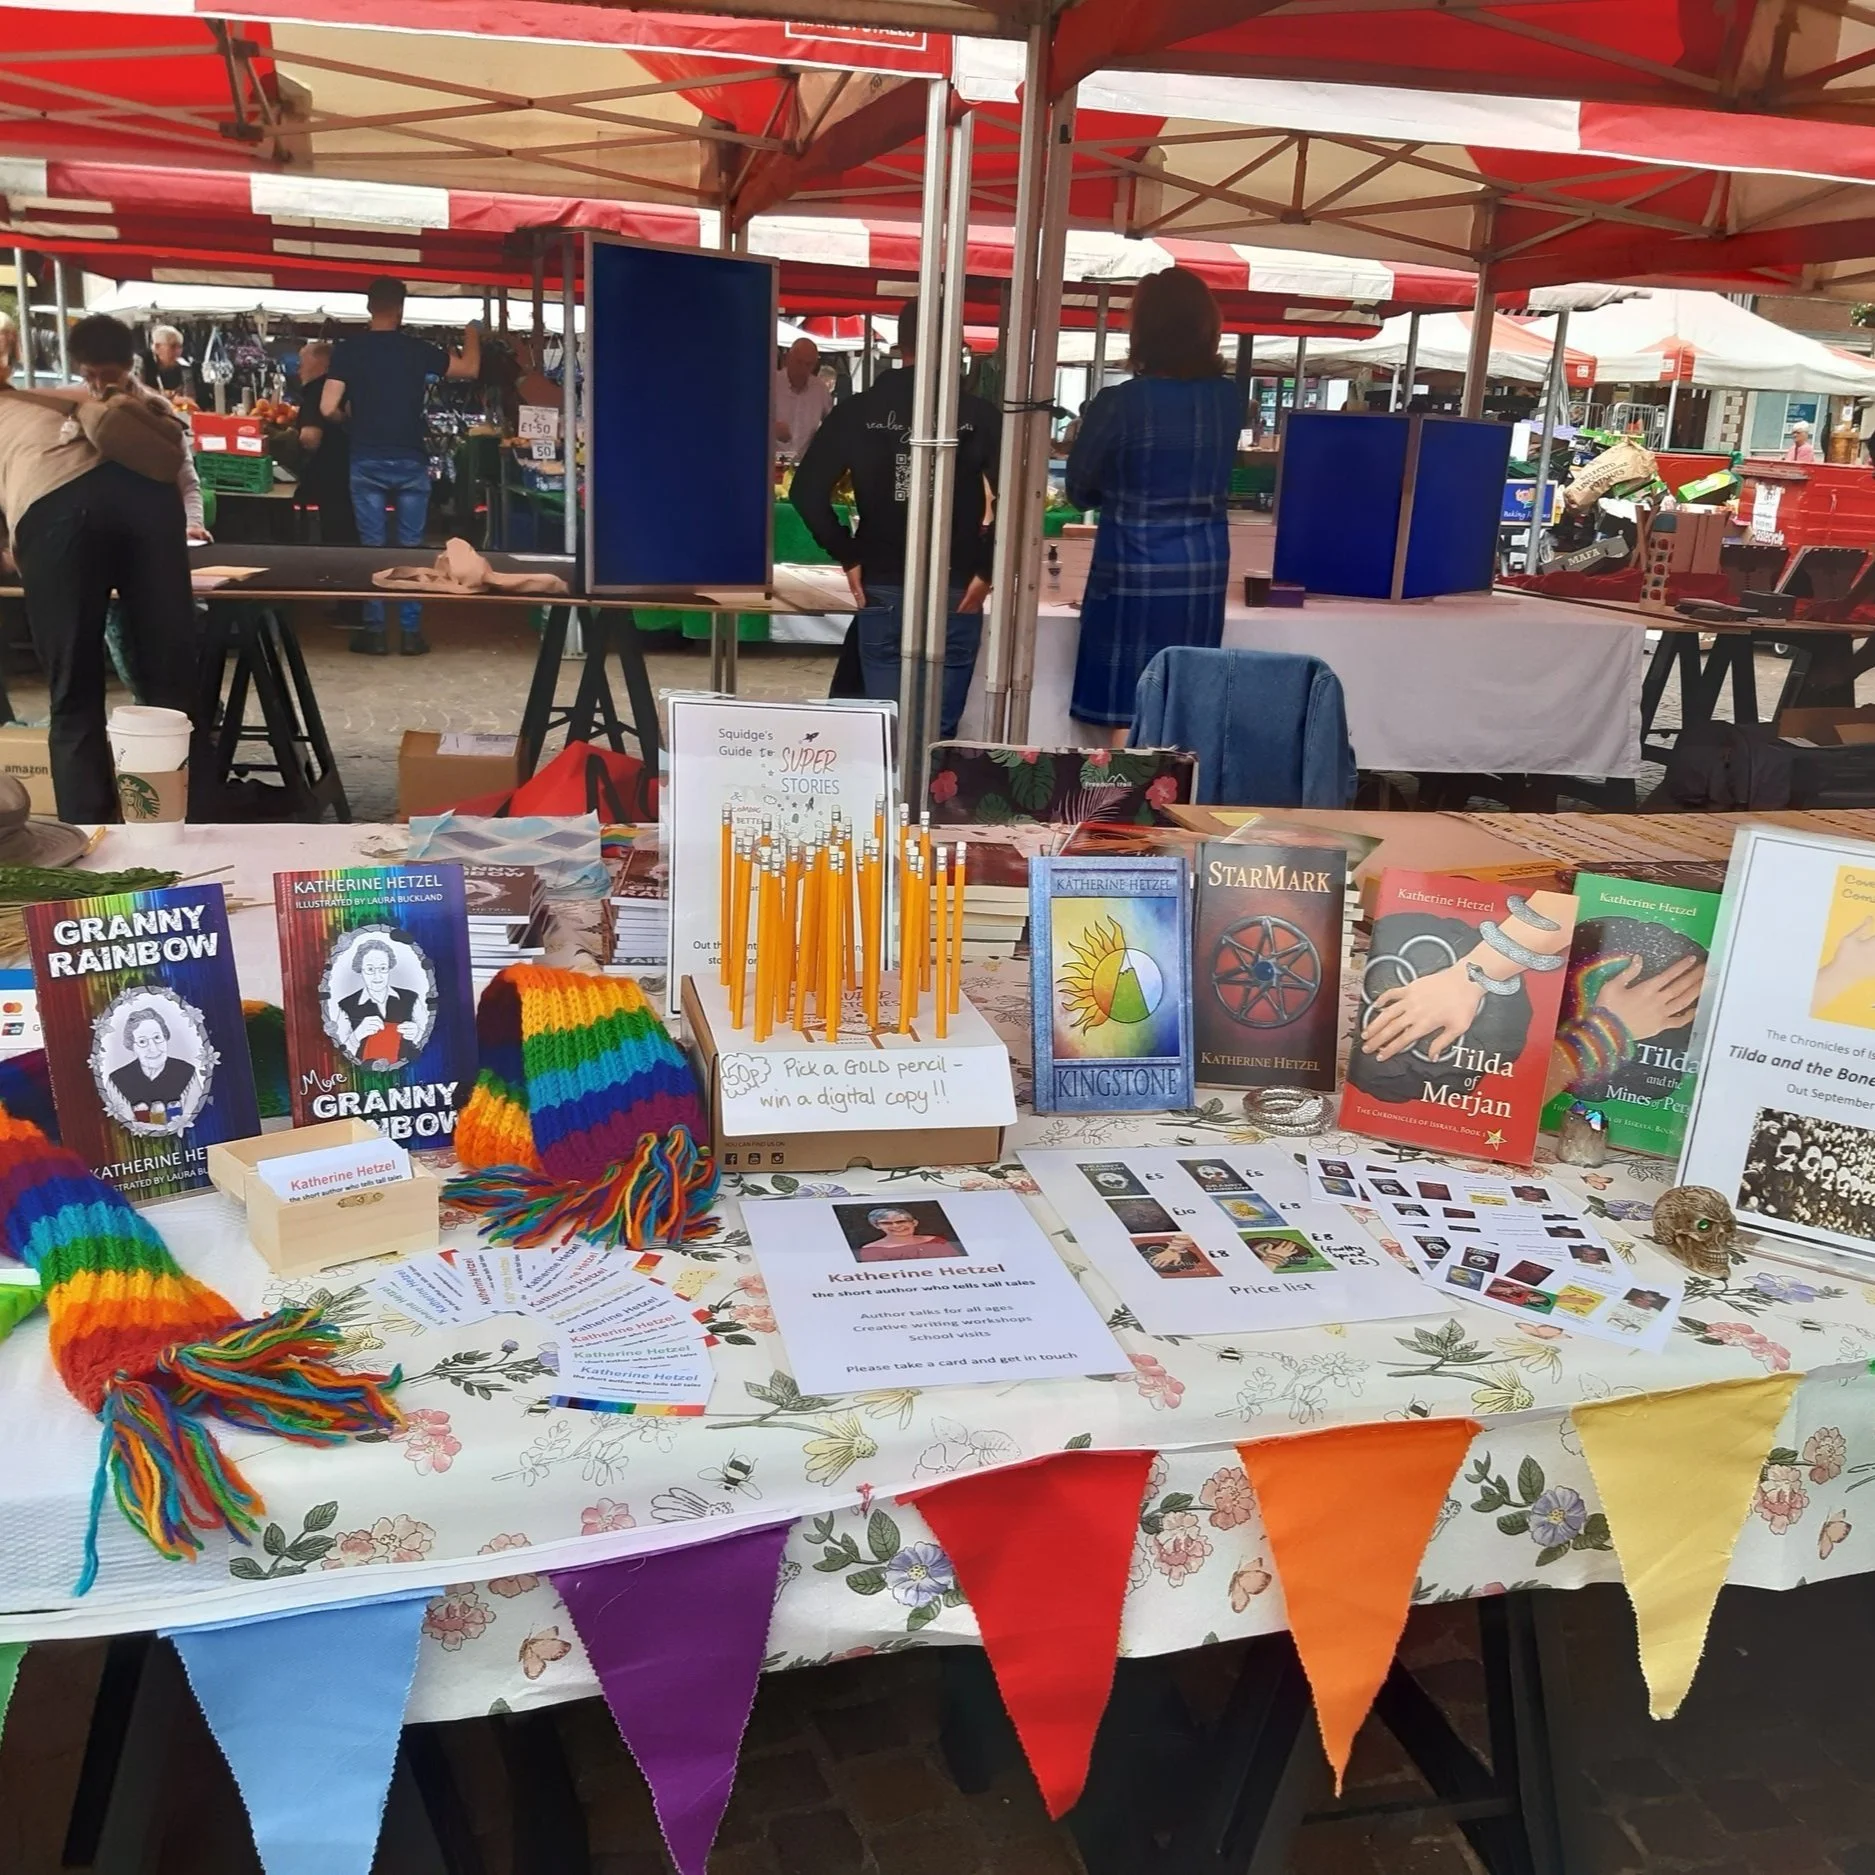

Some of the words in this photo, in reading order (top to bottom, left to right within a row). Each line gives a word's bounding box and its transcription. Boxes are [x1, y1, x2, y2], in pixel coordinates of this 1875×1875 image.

[1567, 547, 1601, 566] MAFA
[718, 728, 774, 741] Squidge's
[718, 745, 753, 757] Guide
[779, 746, 838, 774] SUPER
[4, 764, 48, 775] amazon
[780, 777, 840, 795] STORIES
[293, 877, 383, 895] KATHERINE
[386, 874, 443, 890] HETZEL
[1056, 877, 1123, 892] KATHERINE
[1129, 878, 1173, 892] HETZEL
[295, 898, 353, 909] ILLUSTRATED
[354, 897, 366, 906] BY
[367, 895, 396, 905] LAURA
[397, 893, 443, 904] BUCKLAND
[1398, 887, 1454, 908] Katherine
[1456, 894, 1495, 913] Hetzel
[1600, 891, 1656, 911] Katherine
[1658, 902, 1698, 918] Hetzel
[53, 904, 205, 946] GRANNY
[48, 932, 218, 979] RAINBOW
[692, 940, 712, 951] Out
[1766, 1029, 1787, 1042] The
[1789, 1034, 1850, 1055] Chronicles
[1852, 1048, 1865, 1059] of
[783, 1057, 818, 1079] Pick
[823, 1064, 838, 1076] a
[844, 1059, 890, 1075] GOLD
[897, 1055, 947, 1079] pencil
[1201, 1051, 1271, 1070] KATHERINE
[1451, 1045, 1514, 1078] Tilda
[1637, 1043, 1700, 1074] Tilda
[1728, 1044, 1767, 1064] Tilda
[1770, 1056, 1804, 1071] and
[1806, 1062, 1833, 1078] the
[300, 1069, 348, 1095] More
[725, 1063, 760, 1088] 50p
[1056, 1067, 1177, 1099] KINGSTONE
[1463, 1075, 1482, 1091] of
[1646, 1075, 1666, 1087] and
[1667, 1078, 1684, 1090] the
[312, 1081, 459, 1119] GRANNY
[760, 1095, 790, 1108] win
[797, 1094, 812, 1106] a
[817, 1086, 875, 1113] digital
[1420, 1081, 1512, 1119] Merjan
[1605, 1084, 1652, 1107] Mines
[1651, 1099, 1662, 1110] of
[1786, 1083, 1809, 1097] Out
[1811, 1088, 1875, 1110] September
[365, 1110, 459, 1140] NBOW
[89, 1152, 181, 1180] KATHERINE
[153, 1175, 164, 1186] BY
[166, 1168, 195, 1183] LAURA
[290, 1171, 354, 1192] Katherine
[356, 1159, 396, 1177] Hetzel
[1145, 1172, 1165, 1181] £5
[288, 1195, 301, 1203] the
[302, 1191, 321, 1201] short
[322, 1186, 344, 1196] author
[345, 1183, 360, 1191] who
[361, 1179, 375, 1188] tells
[375, 1177, 387, 1185] tall
[387, 1174, 403, 1182] tales
[1172, 1207, 1197, 1216] £10
[1279, 1202, 1301, 1210] £8
[579, 1252, 599, 1271] Hetzel
[1208, 1249, 1230, 1258] £8
[524, 1262, 562, 1289] Katherine
[558, 1243, 582, 1263] Hetzel
[828, 1269, 934, 1283] Katherine
[939, 1263, 1006, 1276] Hetzel
[527, 1283, 578, 1308] Katherine
[576, 1267, 608, 1286] Hetzel
[837, 1288, 873, 1297] short
[875, 1286, 918, 1295] author
[953, 1282, 980, 1290] tells
[982, 1280, 1003, 1288] tall
[1229, 1283, 1281, 1295] Price
[1283, 1282, 1317, 1292] list
[567, 1312, 623, 1333] Katherine
[623, 1296, 659, 1314] Hetzel
[860, 1311, 907, 1319] Author
[909, 1308, 941, 1317] talks
[966, 1305, 982, 1313] all
[985, 1304, 1014, 1313] ages
[569, 1326, 634, 1343] Katherine
[636, 1314, 677, 1329] Hetzel
[853, 1323, 908, 1333] Creative
[911, 1320, 960, 1329] writing
[961, 1315, 1033, 1326] workshops
[908, 1332, 955, 1342] School
[957, 1330, 992, 1338] visits
[573, 1350, 642, 1359] Katherine
[646, 1345, 690, 1355] Hetzel
[846, 1364, 891, 1374] Please
[894, 1361, 924, 1370] take
[938, 1358, 967, 1367] card
[971, 1356, 997, 1364] and
[1000, 1355, 1021, 1364] get
[1039, 1350, 1078, 1361] touch
[580, 1366, 650, 1380] Katherine
[654, 1373, 699, 1381] Hetzel
